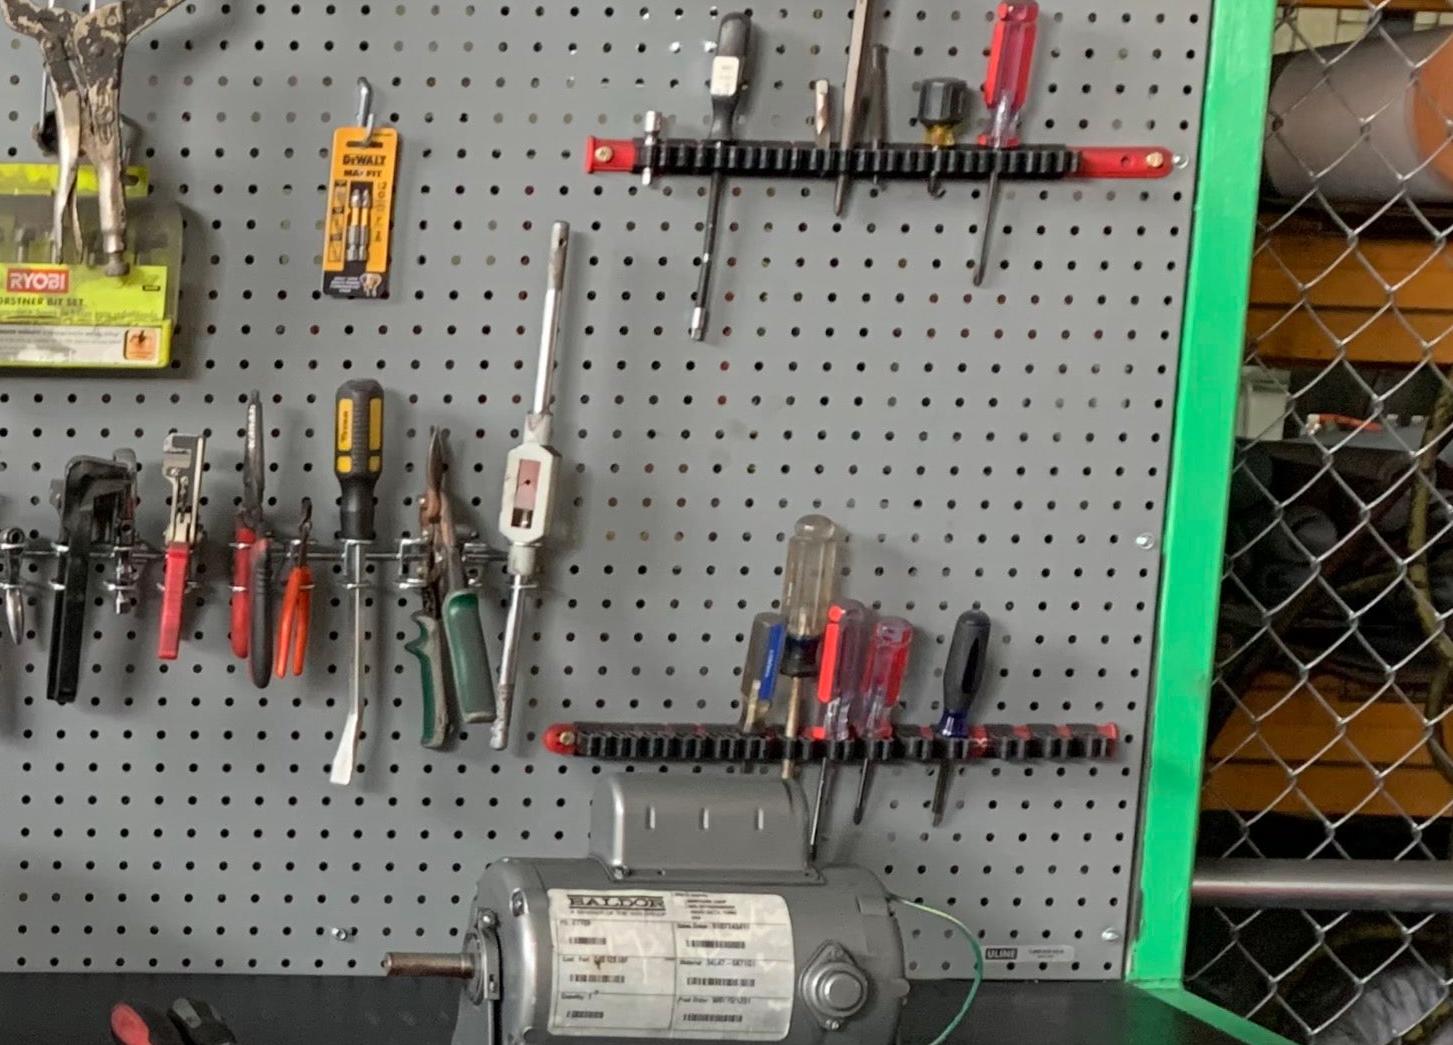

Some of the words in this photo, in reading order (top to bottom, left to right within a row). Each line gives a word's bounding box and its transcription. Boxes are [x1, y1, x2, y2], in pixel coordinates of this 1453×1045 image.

[9, 272, 66, 289] RYOBI
[46, 297, 63, 306] BIT
[568, 895, 665, 910] BALDOR
